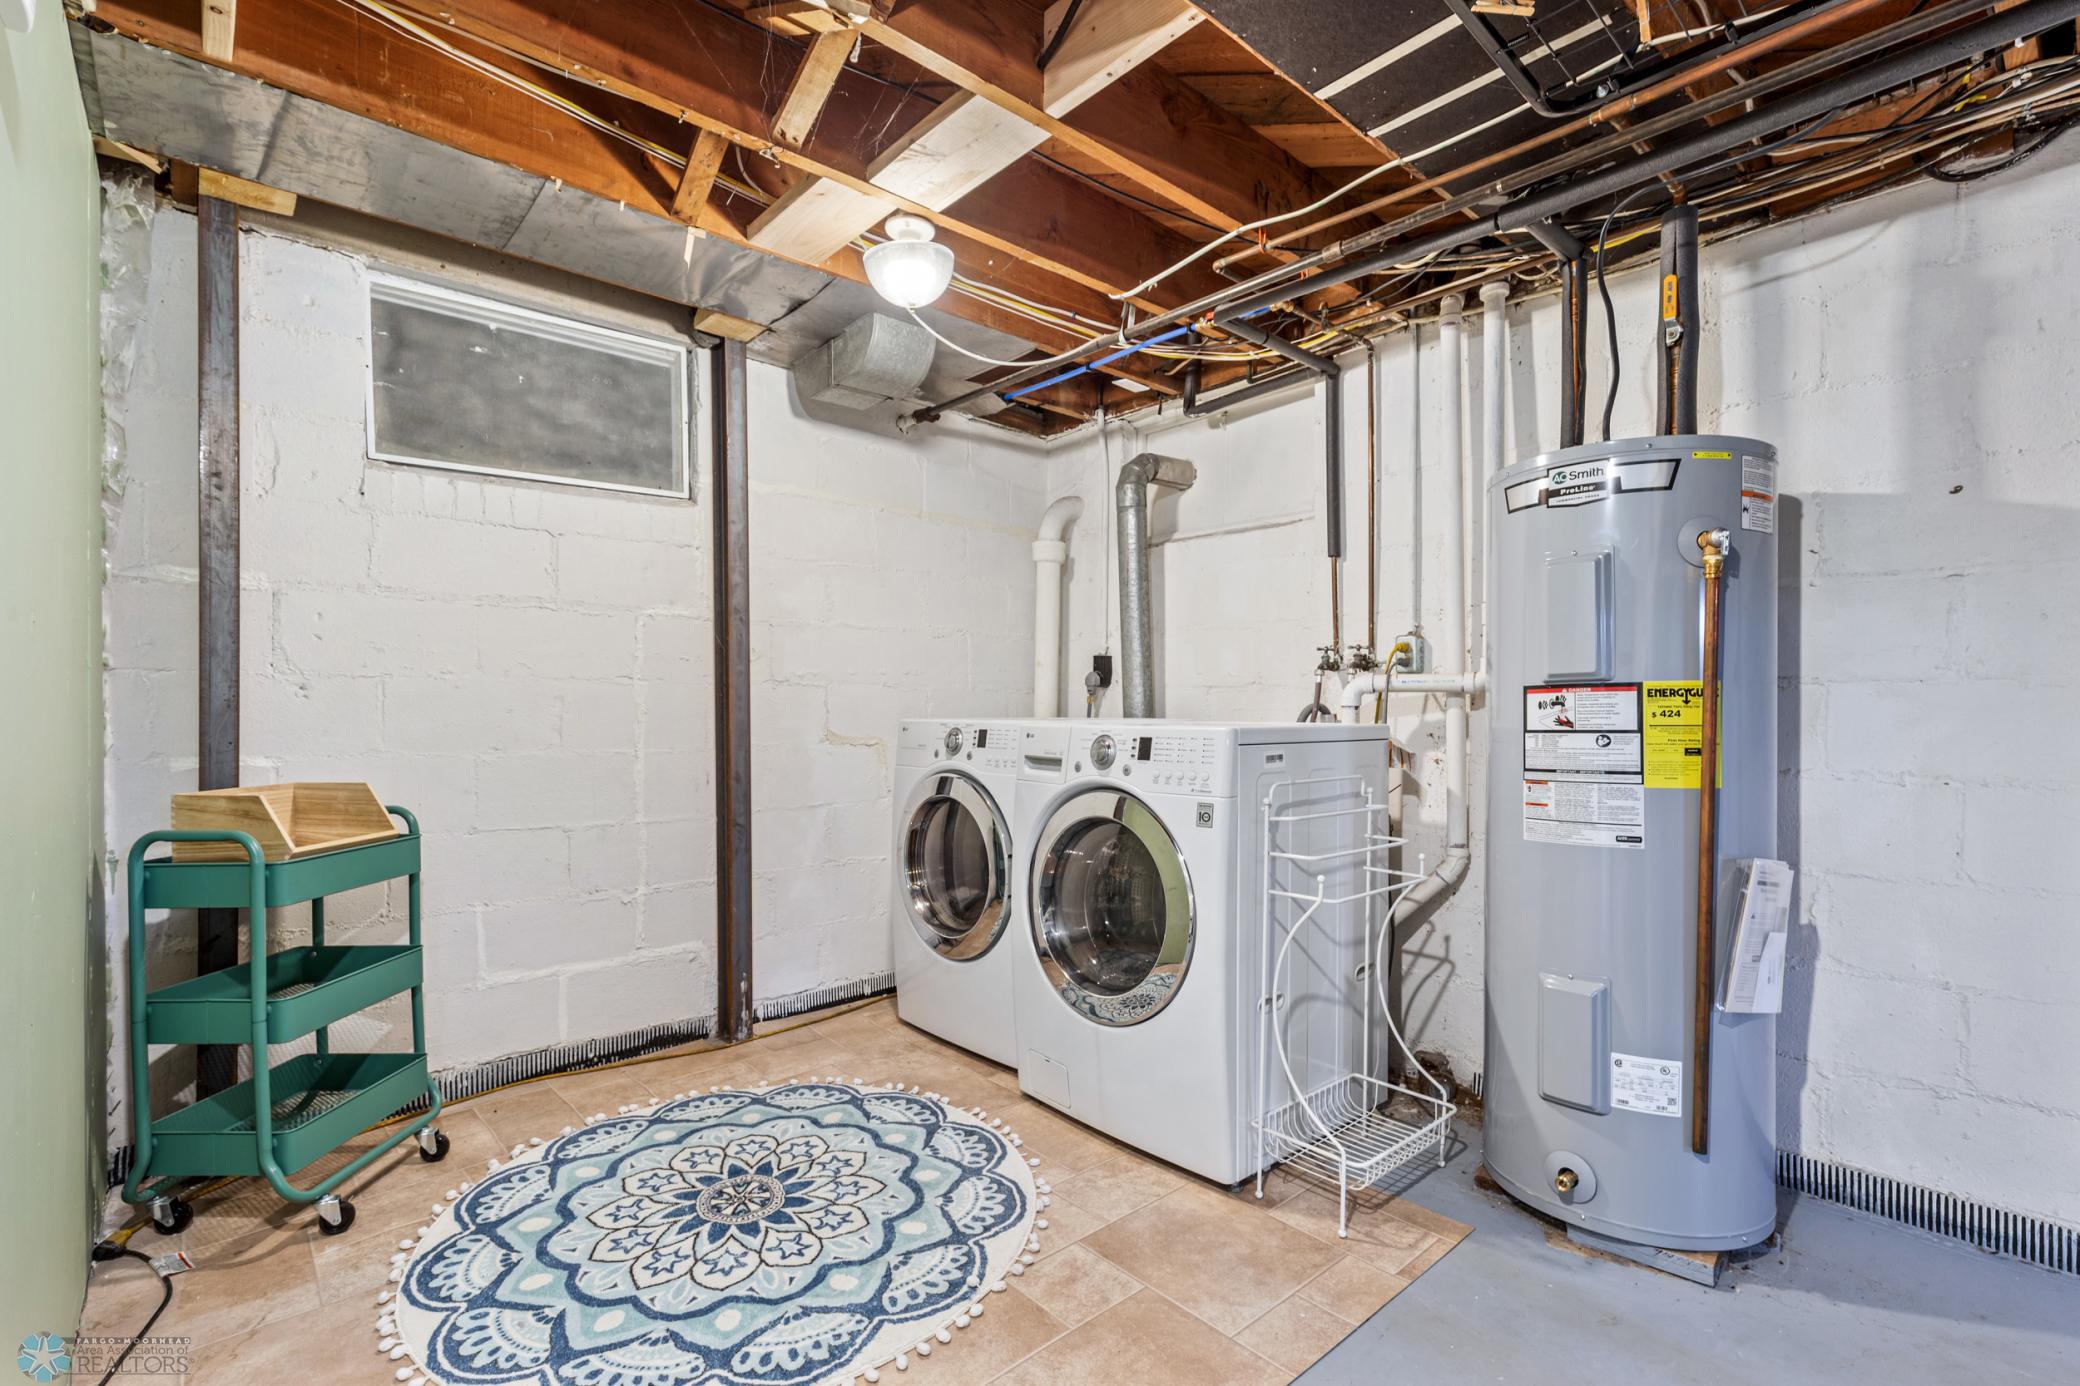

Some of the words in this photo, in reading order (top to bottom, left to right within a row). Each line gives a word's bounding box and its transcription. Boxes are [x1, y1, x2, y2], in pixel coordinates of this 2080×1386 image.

[1569, 467, 1604, 480] Smith
[1647, 688, 1719, 698] ENERGYGU
[1660, 709, 1682, 718] 424
